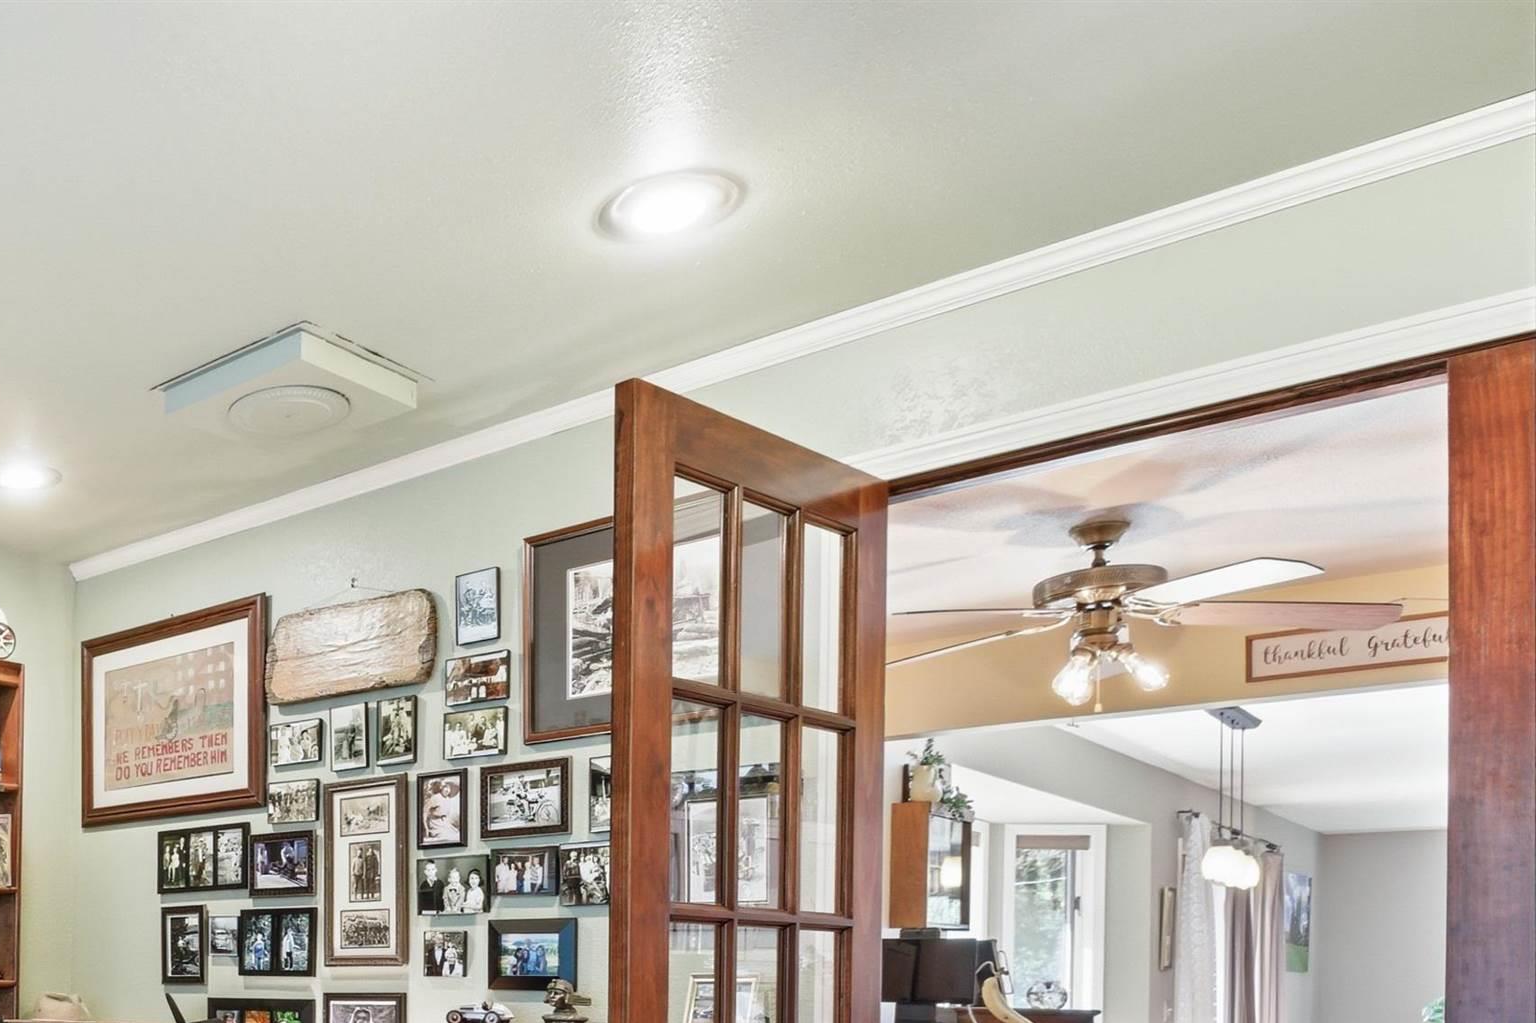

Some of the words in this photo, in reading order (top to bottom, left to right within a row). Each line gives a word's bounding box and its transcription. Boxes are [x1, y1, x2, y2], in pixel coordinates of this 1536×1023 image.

[1263, 636, 1350, 665] thankful
[134, 737, 194, 761] REMEMBERS
[199, 732, 228, 749] THEM
[115, 765, 131, 781] DO
[134, 761, 153, 778] YOU
[155, 750, 209, 774] REMEMBER
[210, 749, 228, 764] HIM
